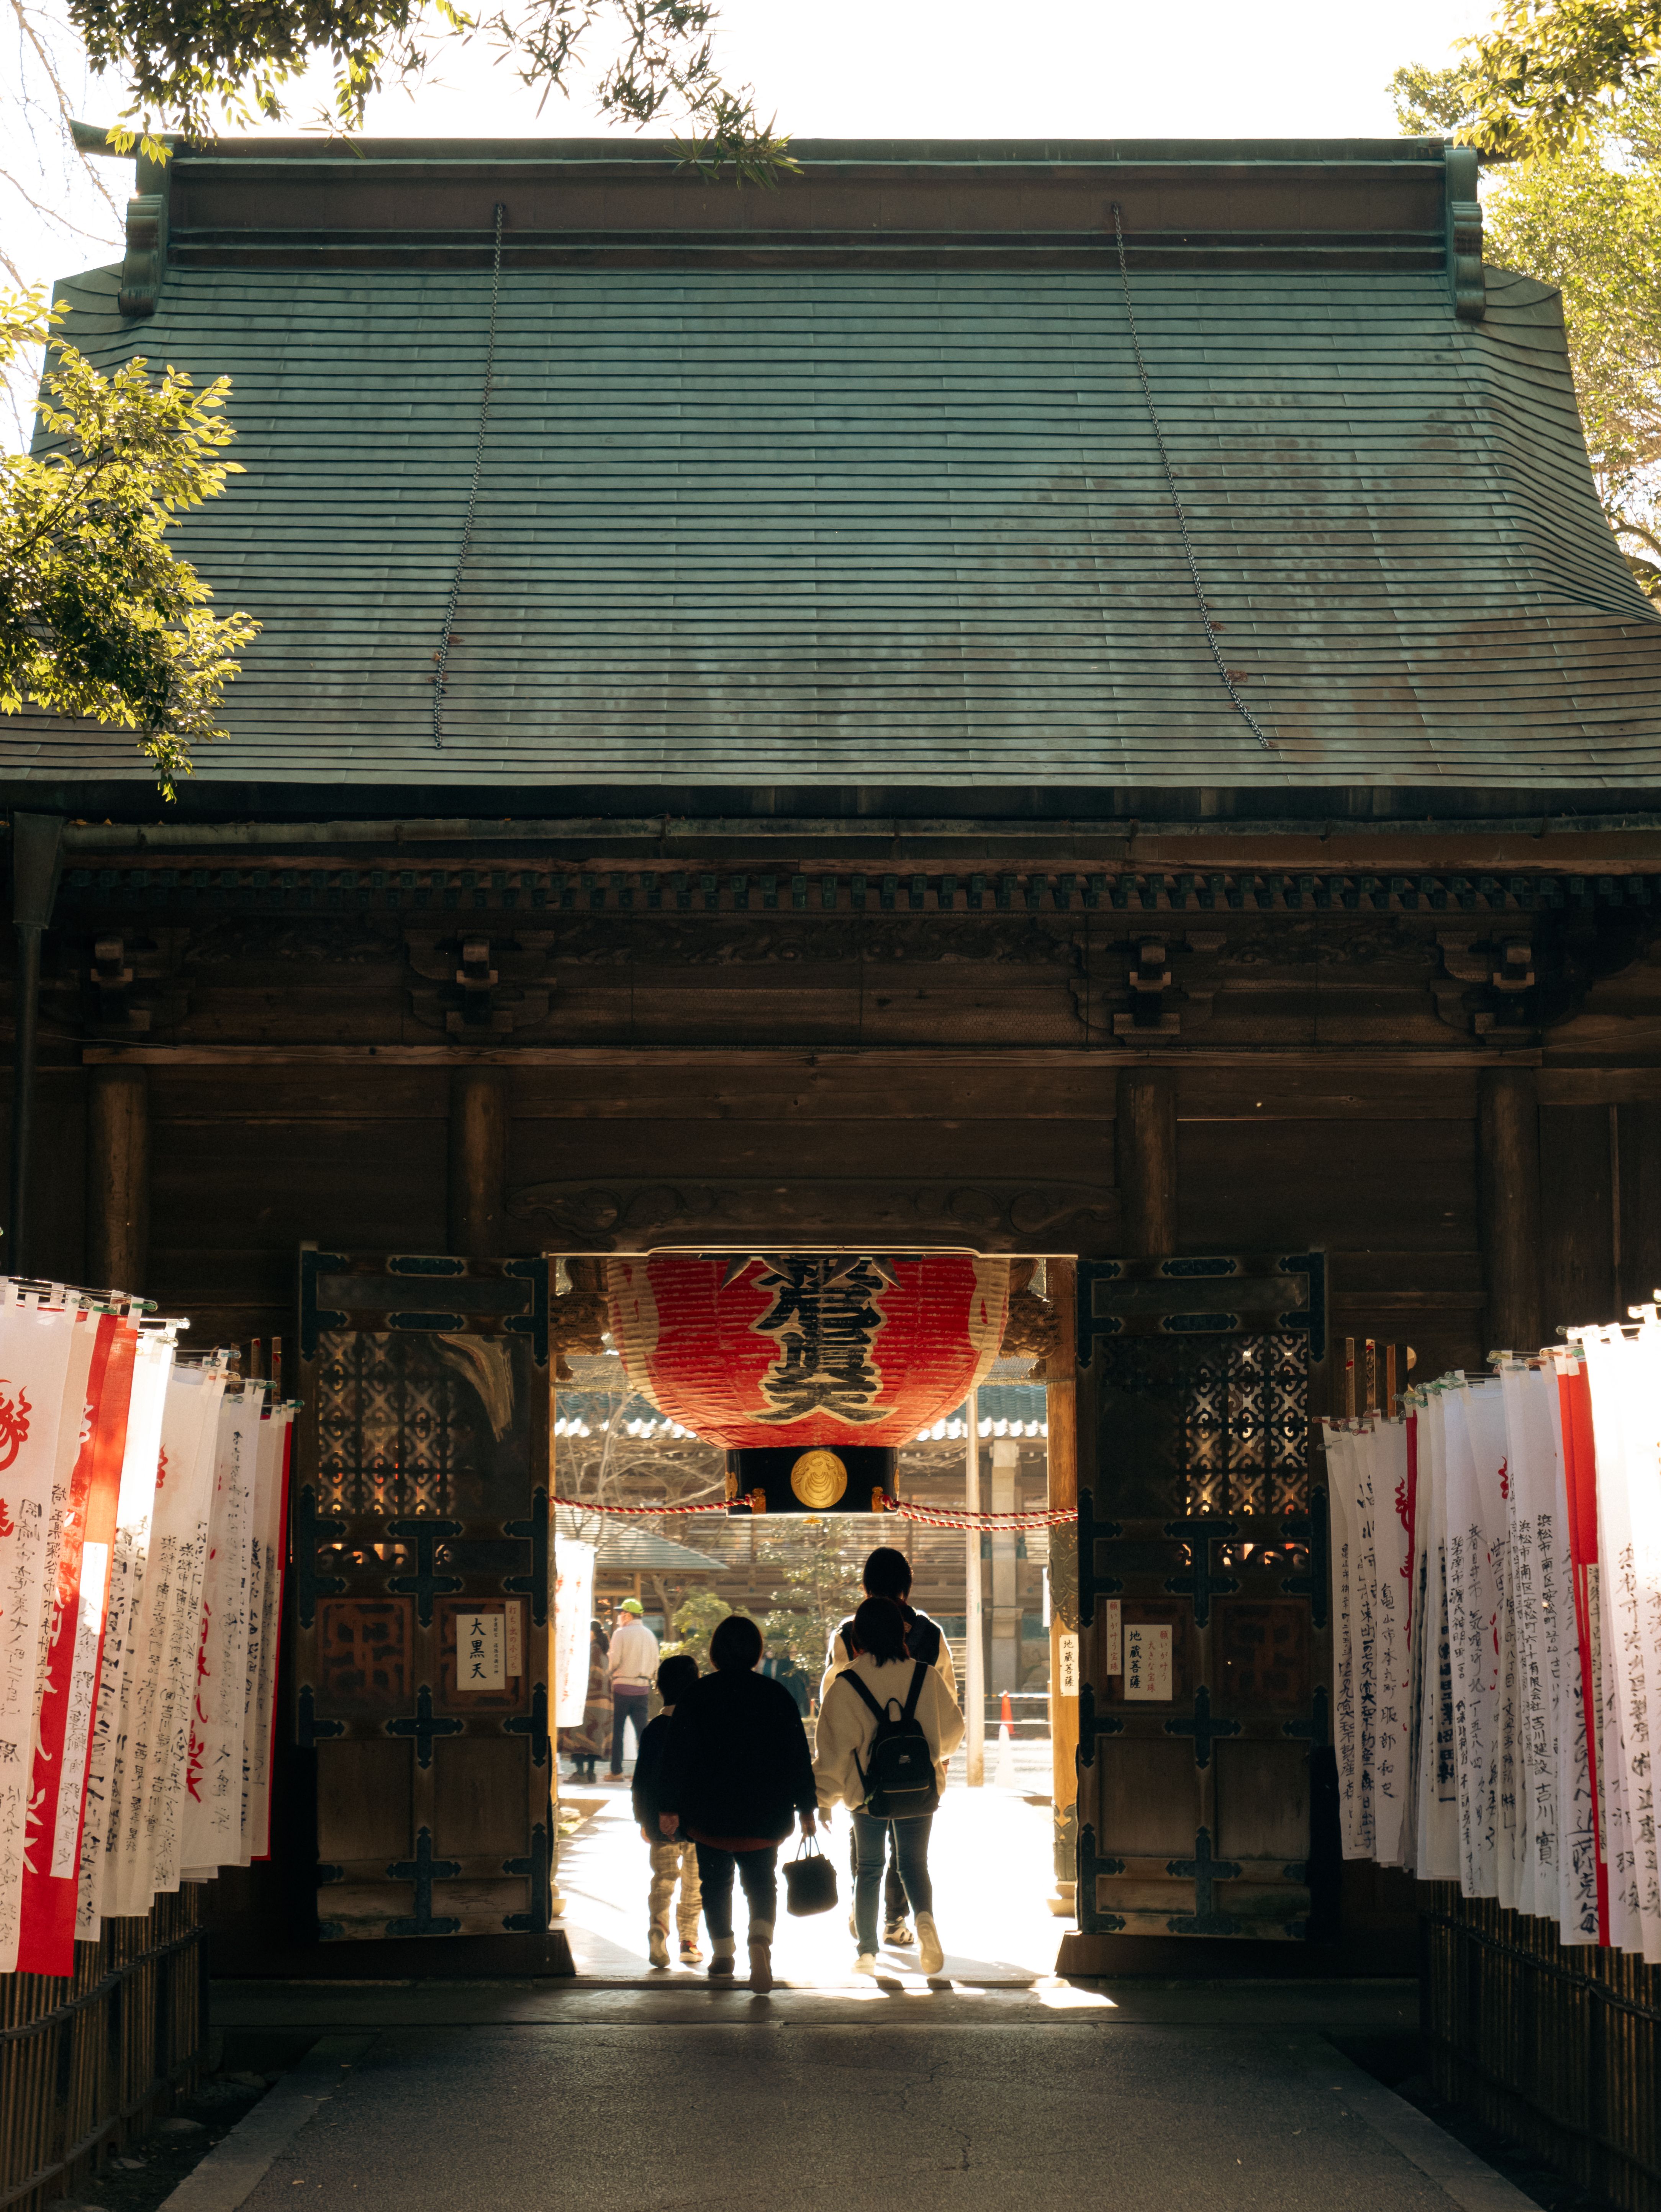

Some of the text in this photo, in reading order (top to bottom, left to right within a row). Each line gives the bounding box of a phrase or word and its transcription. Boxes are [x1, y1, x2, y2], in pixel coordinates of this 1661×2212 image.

[469, 1618, 487, 1679] 大黒天
[1063, 1639, 1075, 1687] 地蔵菩薩
[1109, 1602, 1119, 1671] 願いが叶う宝珠
[1129, 1631, 1142, 1689] 地蔵菩薩
[1160, 1630, 1169, 1681] 願いが叶う
[1147, 1641, 1156, 1693] 大きな宝珠
